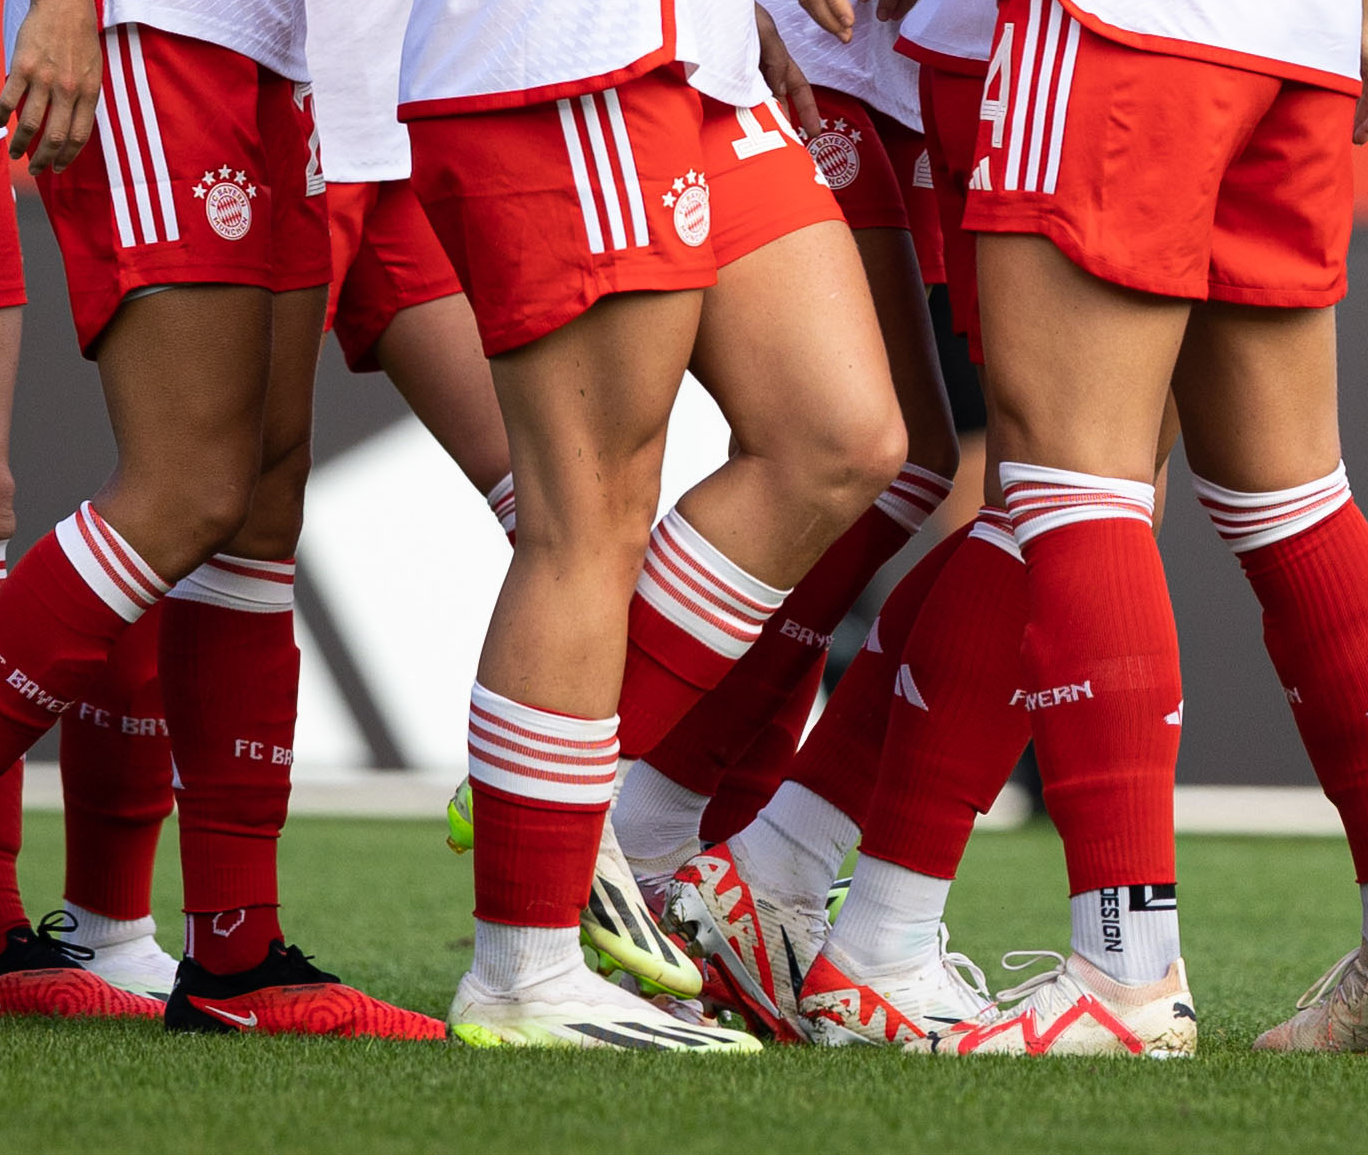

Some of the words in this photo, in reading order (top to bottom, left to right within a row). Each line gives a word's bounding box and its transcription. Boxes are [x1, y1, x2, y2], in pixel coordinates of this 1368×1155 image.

[980, 22, 1015, 148] 4
[79, 692, 111, 728] FC
[234, 738, 264, 760] FC
